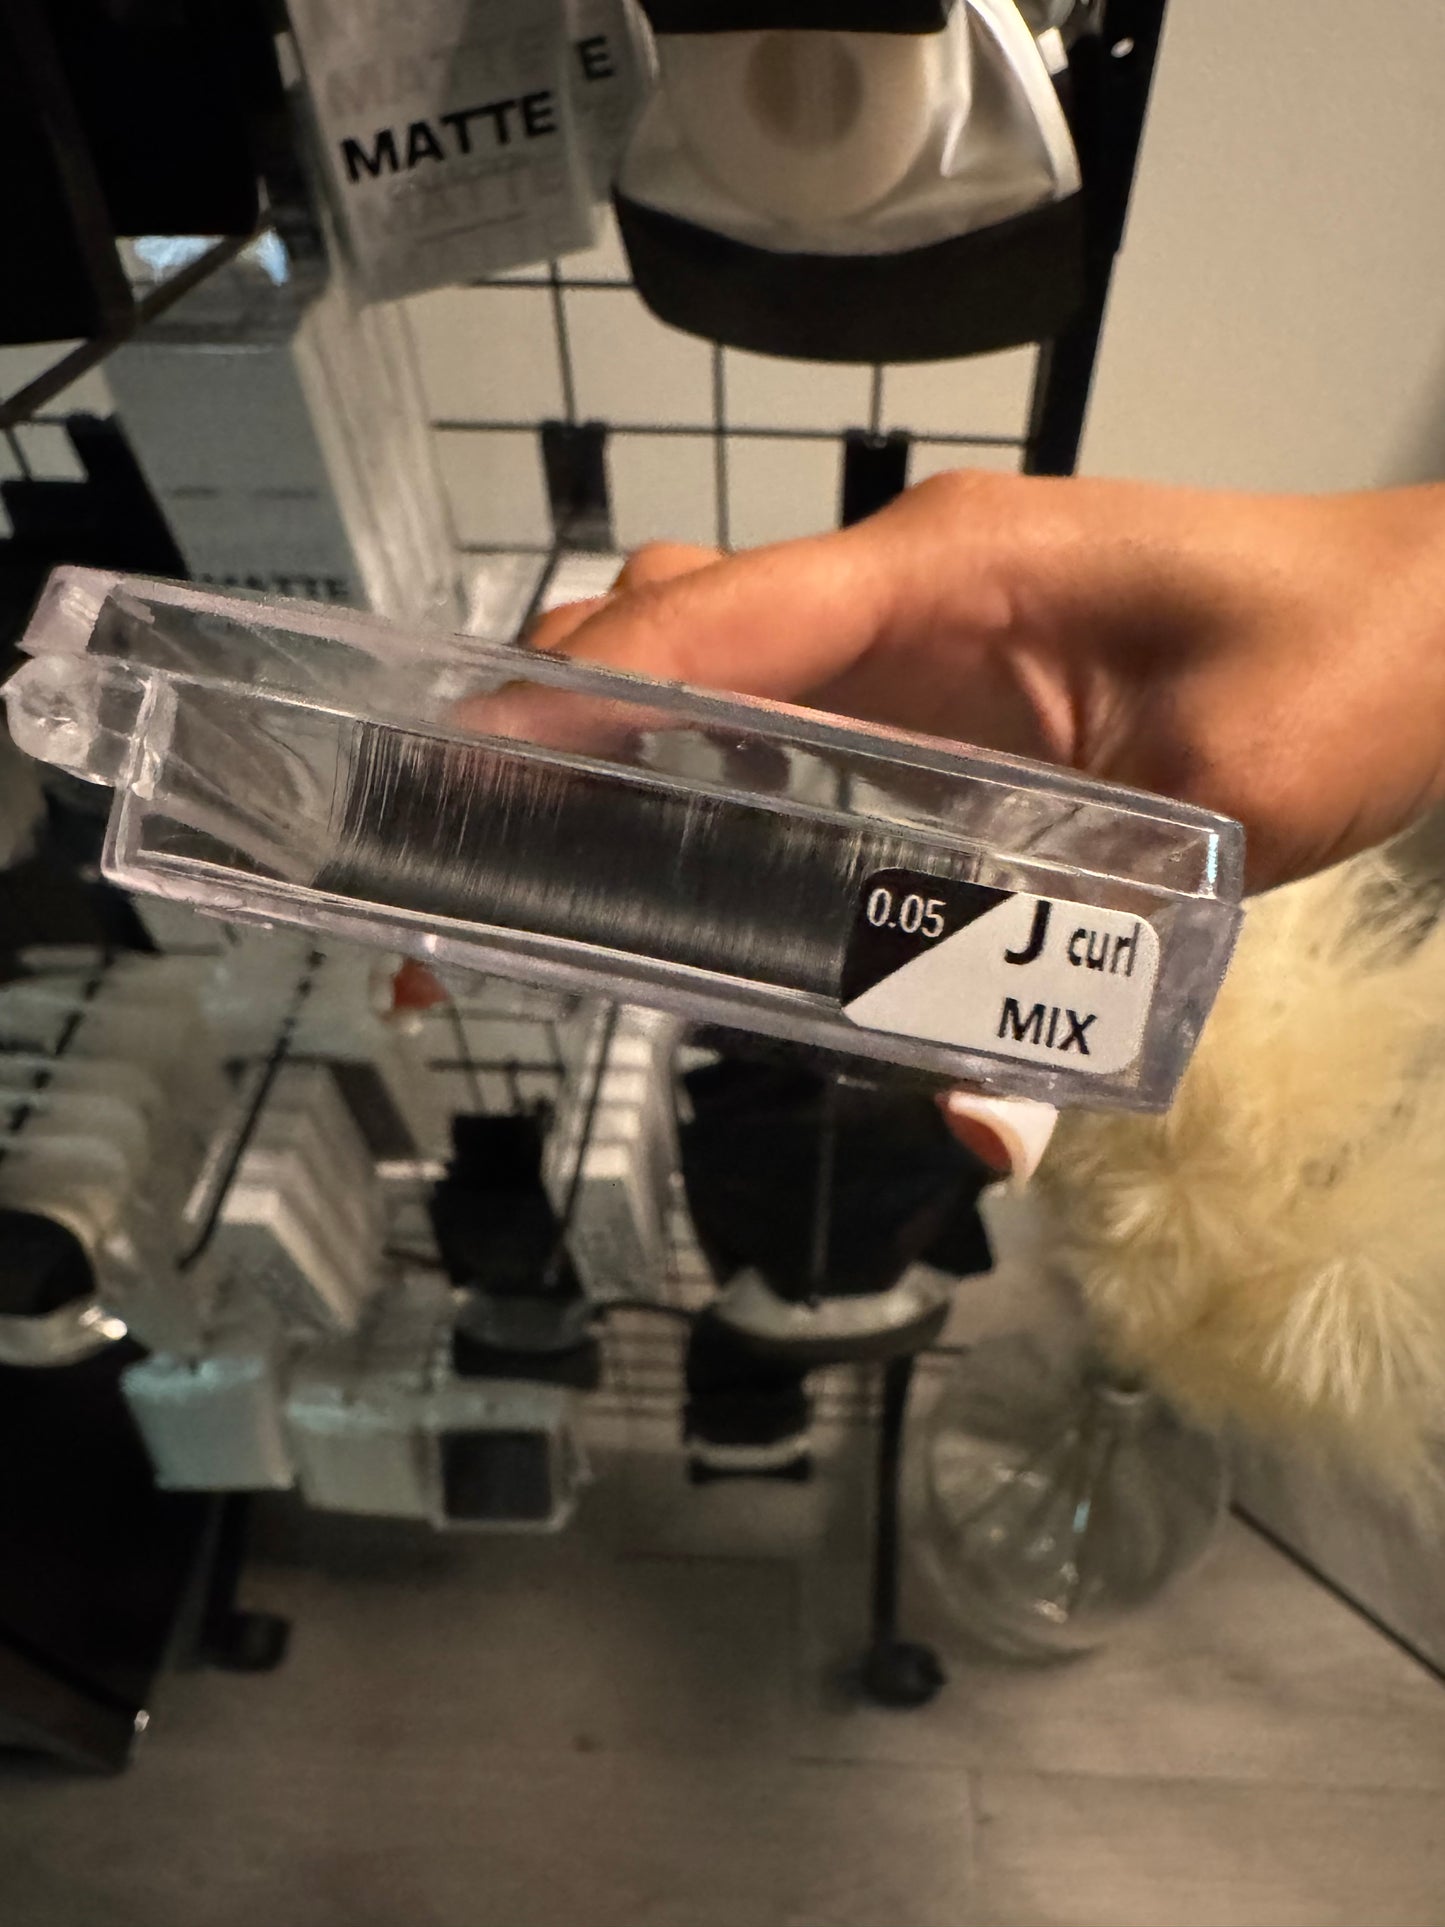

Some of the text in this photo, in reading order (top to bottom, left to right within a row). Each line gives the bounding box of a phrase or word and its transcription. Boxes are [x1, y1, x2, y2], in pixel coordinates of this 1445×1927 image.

[341, 91, 557, 182] MATTE
[867, 888, 946, 938] 0.05
[1004, 900, 1141, 977] J curl
[997, 997, 1096, 1055] MIX
